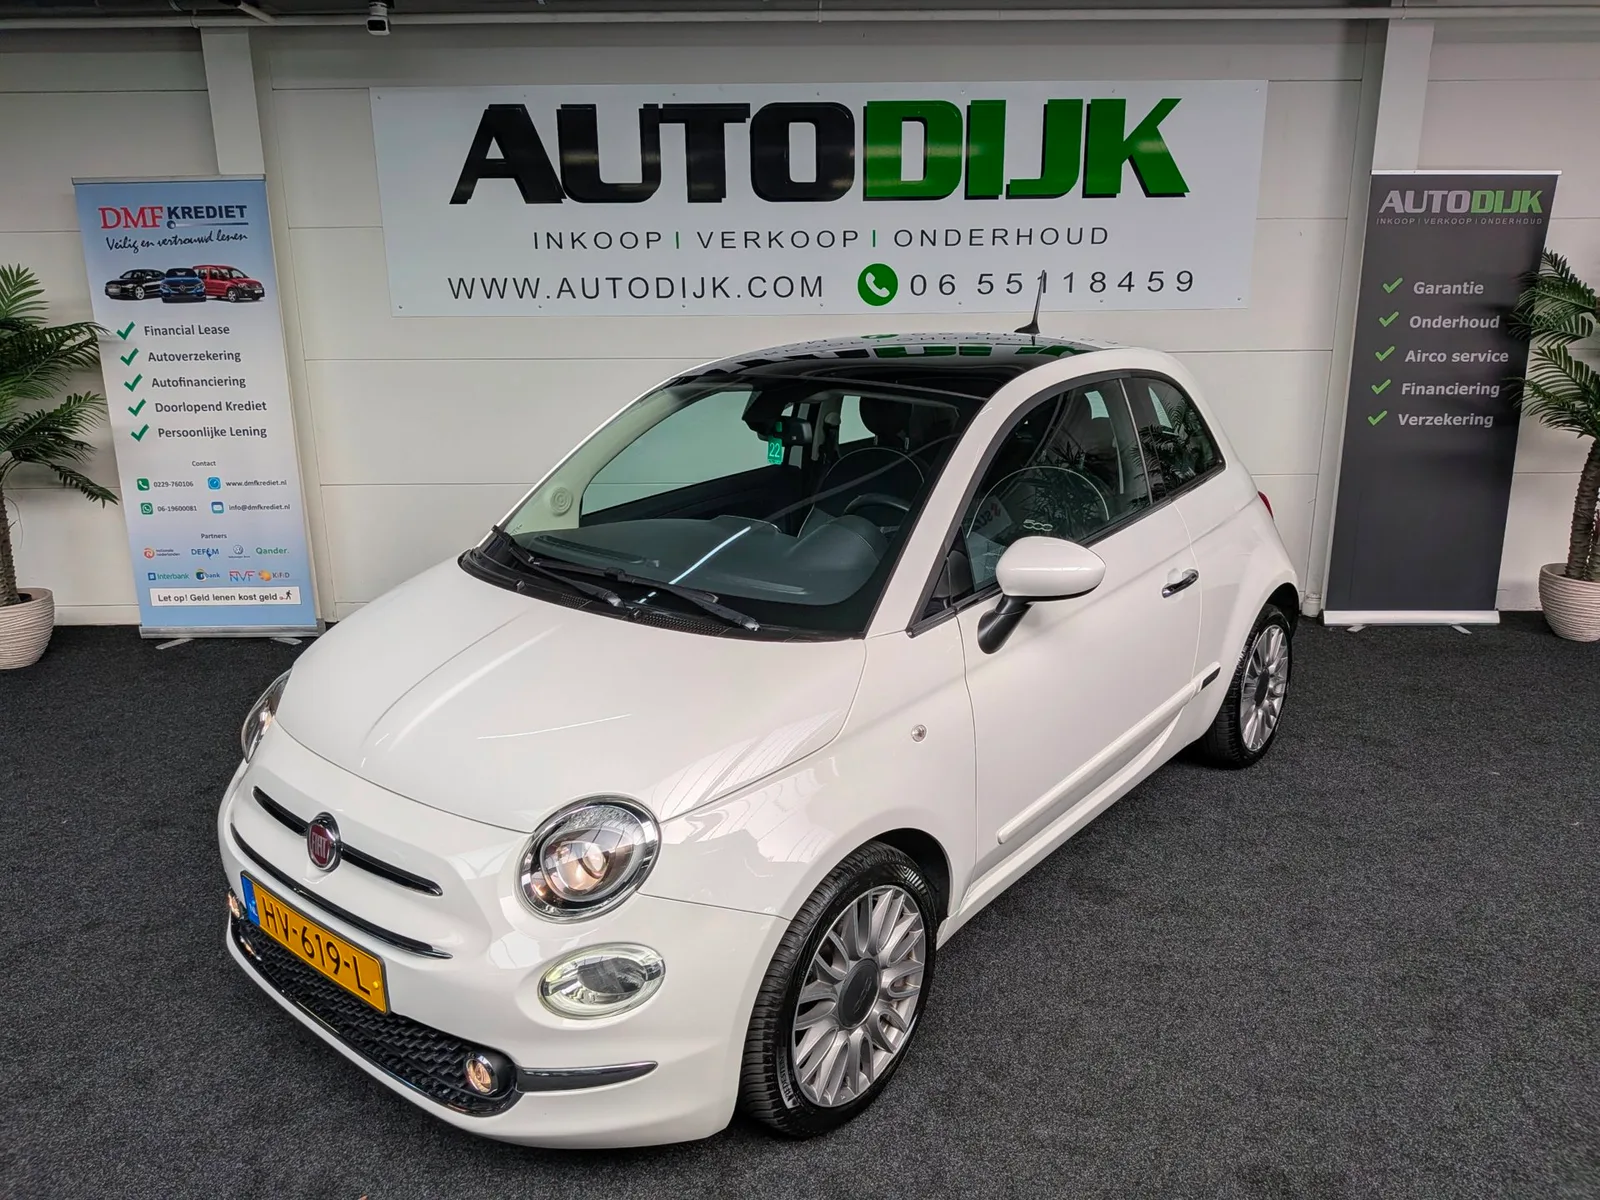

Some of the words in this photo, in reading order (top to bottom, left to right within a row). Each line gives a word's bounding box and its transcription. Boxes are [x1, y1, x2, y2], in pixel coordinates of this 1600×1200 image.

[449, 98, 1190, 204] AUTODIJK
[1379, 190, 1543, 214] AUTODIJK
[98, 205, 163, 229] DMF
[167, 205, 248, 220] KREDIET
[1480, 217, 1543, 225] ONDERHOUD
[106, 236, 139, 254] Veilig
[141, 240, 155, 248] en
[157, 230, 213, 247] vertrouwd
[216, 229, 248, 242] lenen
[533, 231, 662, 250] INKOOP
[697, 229, 860, 249] VERKOOP
[894, 227, 1109, 247] ONDERHOUD
[448, 275, 823, 300] WWW.AUTODIJK.COM
[910, 273, 956, 297] 06
[1413, 281, 1484, 295] Garantie
[1409, 314, 1500, 329] Onderhoud
[144, 324, 195, 336] Financial
[198, 324, 230, 335] Lease
[148, 350, 241, 363] Autoverzekering
[1405, 349, 1447, 363] Airco
[1451, 349, 1509, 363] service
[151, 376, 246, 389] Autofinanciering
[1401, 382, 1500, 398] Financiering
[155, 402, 223, 414] Doorlopend
[226, 401, 267, 412] Krediet
[1398, 413, 1493, 428] Verzekering
[158, 426, 227, 439] Persoonlijke
[230, 426, 267, 438] Lening
[769, 442, 781, 458] 22
[225, 479, 287, 487] www.dmfkrediet.nl
[229, 503, 291, 511] info@dmfkrediet.nl
[158, 594, 172, 602] Let
[174, 594, 188, 603] op!
[190, 593, 210, 601] Geld
[212, 593, 236, 601] lenen
[238, 593, 257, 601] kost
[259, 592, 277, 602] geld
[311, 832, 328, 858] FIAT
[262, 896, 371, 995] HV-619-L
